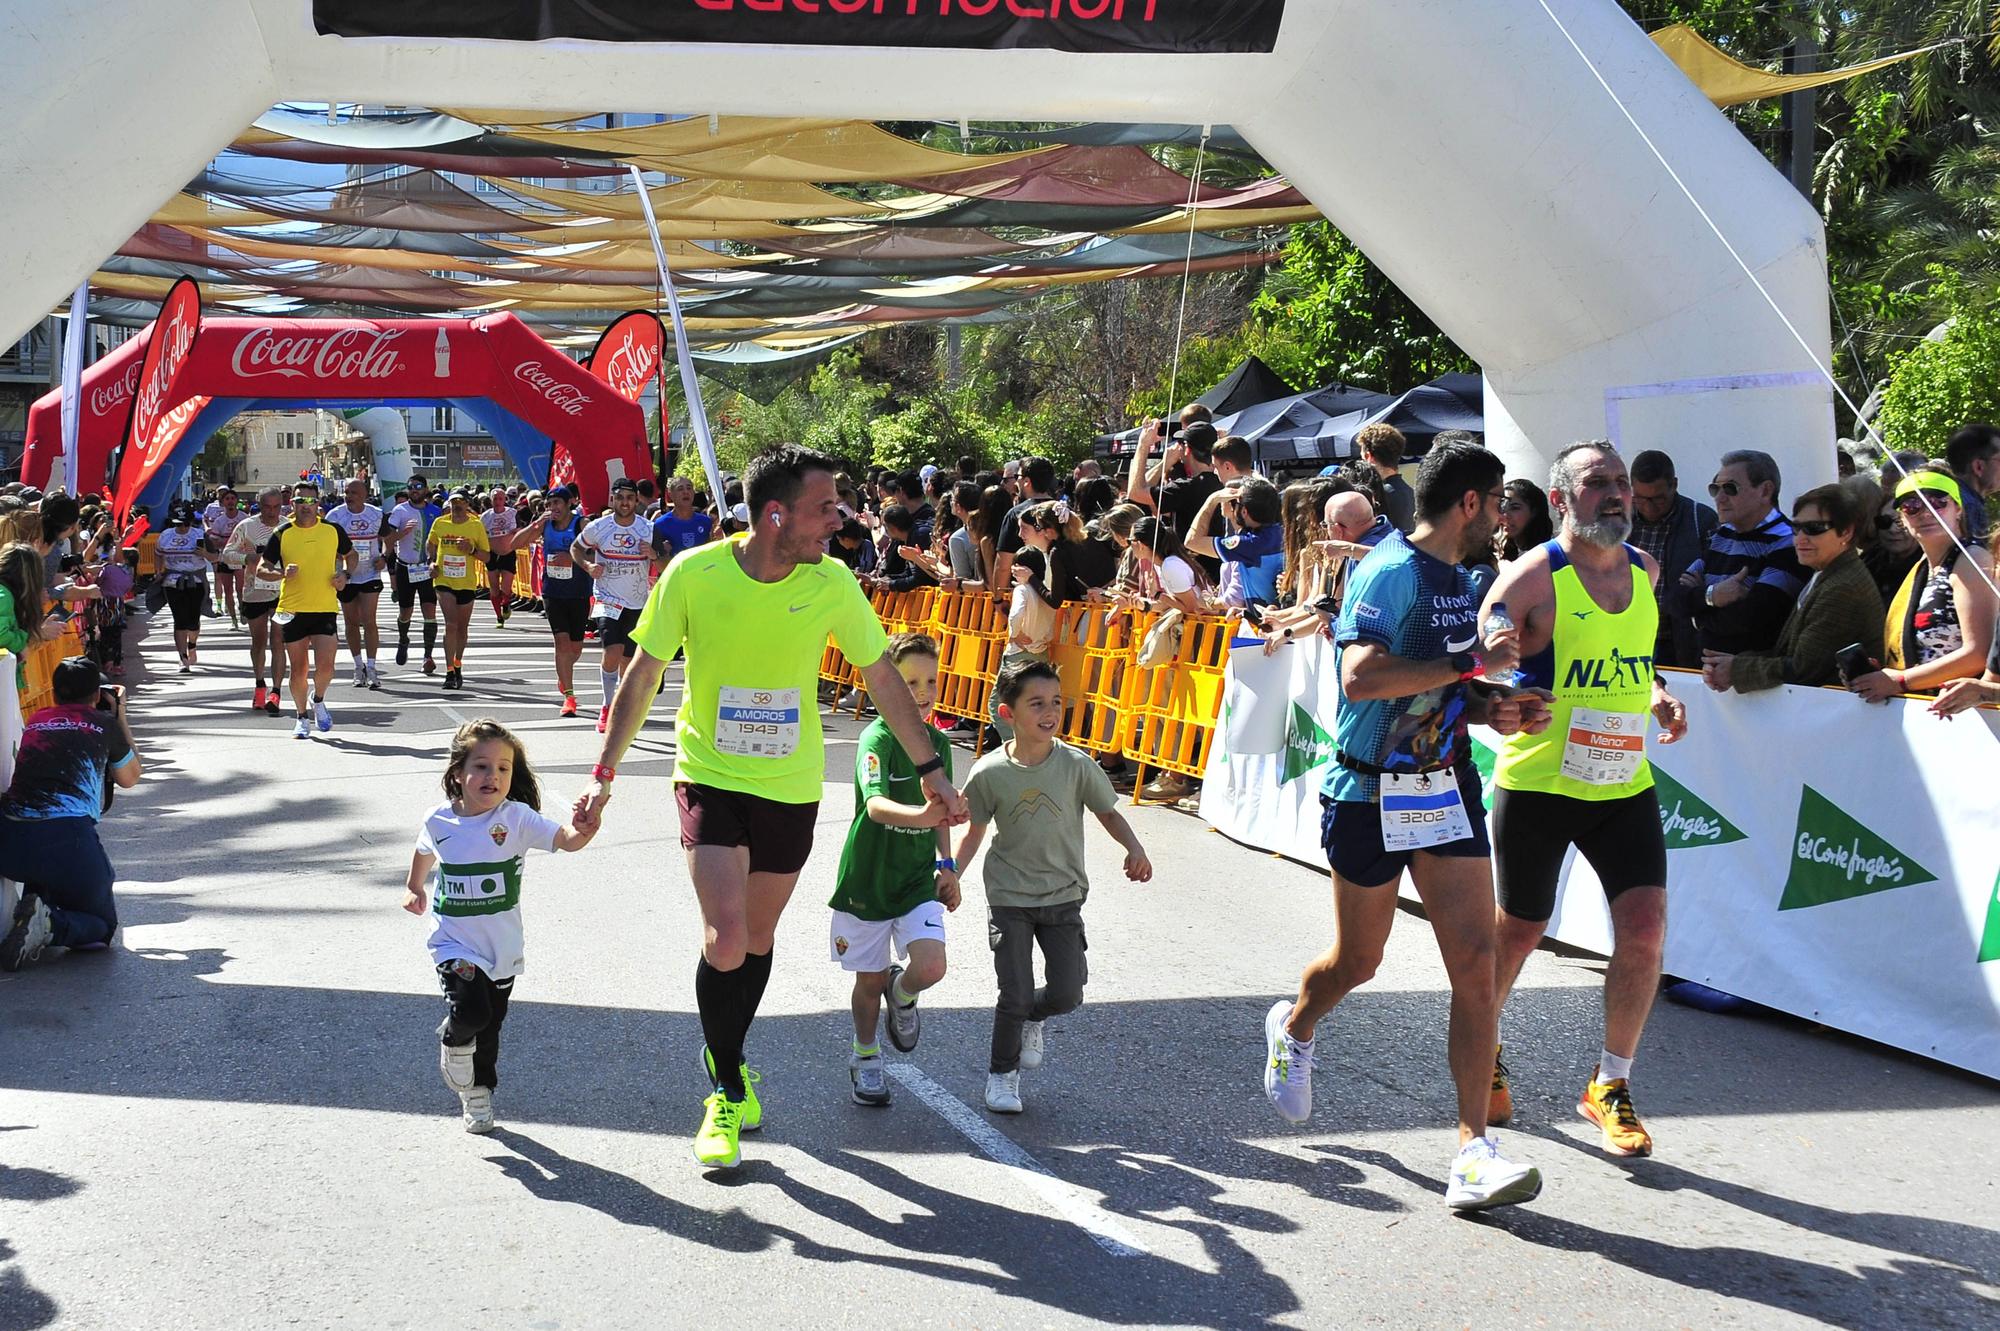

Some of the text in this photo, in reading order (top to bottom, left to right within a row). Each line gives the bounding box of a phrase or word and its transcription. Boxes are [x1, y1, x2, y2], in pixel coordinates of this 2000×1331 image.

[232, 327, 408, 378] Coca-Cola
[134, 296, 190, 449] Coca-Cola
[91, 360, 144, 416] Coca-C
[513, 361, 594, 416] Coca-Cola
[733, 709, 786, 721] AMOROS
[738, 723, 779, 735] 1943
[1590, 733, 1629, 748] Menor
[1399, 810, 1447, 824] 3202
[1664, 800, 1722, 841] Inglés
[1798, 831, 1904, 884] El Corte Inglés
[447, 881, 465, 895] TM
[467, 899, 487, 907] Estate
[487, 898, 506, 906] Group
